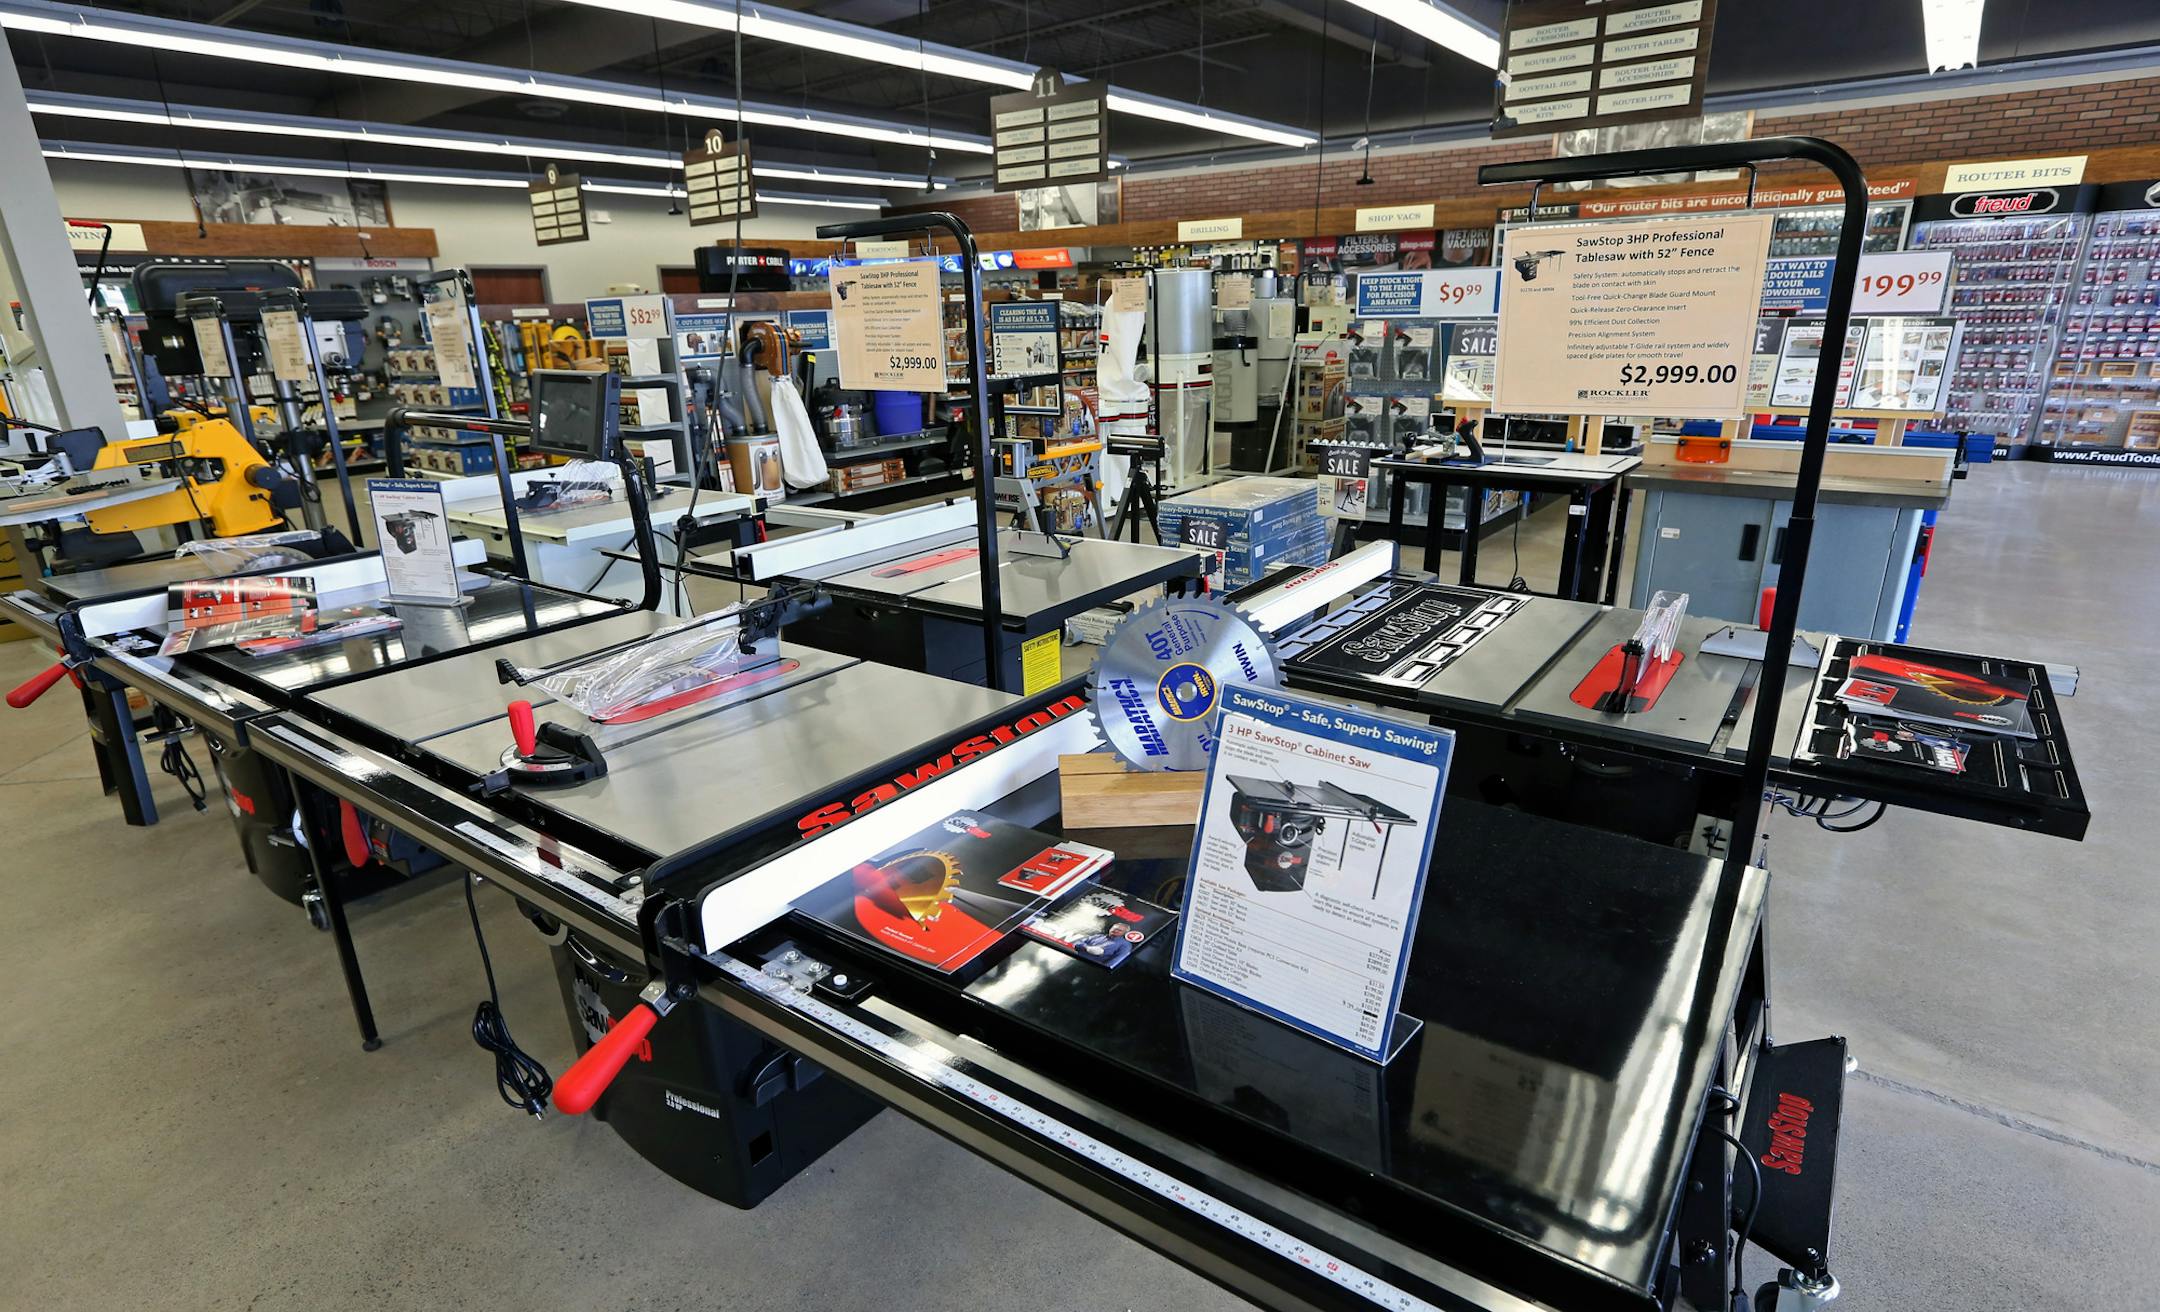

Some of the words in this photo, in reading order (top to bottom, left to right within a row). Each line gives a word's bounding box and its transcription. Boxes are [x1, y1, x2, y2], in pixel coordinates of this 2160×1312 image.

[1634, 9, 1670, 20] ROUTER
[1623, 14, 1682, 28] ACCESSORIES
[1536, 26, 1569, 36] ROUTER
[1526, 31, 1580, 44] ACCESSORIES
[1614, 42, 1650, 53] ROUTER
[1652, 37, 1685, 48] TABLES
[1524, 57, 1556, 66] ROUTER
[1558, 54, 1577, 62] JIGS
[1614, 67, 1650, 76] ROUTER
[1652, 62, 1680, 72] TABLE
[1616, 70, 1675, 83] ACCESSORIES
[1036, 76, 1056, 98] 11
[1518, 83, 1557, 92] DOVETAIL
[1558, 80, 1578, 88] JIGS
[1540, 103, 1573, 112] MAKING
[1612, 97, 1647, 106] ROUTER
[705, 136, 722, 154] 10
[548, 170, 556, 184] 9
[1957, 170, 2025, 183] ROUTER
[2032, 166, 2072, 178] BITS
[1619, 198, 1657, 212] router
[1660, 196, 1680, 209] bits
[1682, 197, 1708, 208] are
[1816, 180, 1910, 202] guateed”
[1513, 204, 1570, 216] ROKLER
[1973, 196, 2034, 214] freud
[1368, 214, 1394, 223] SHOP
[1397, 212, 1422, 221] VACS
[1190, 225, 1229, 234] DRILLING
[1345, 235, 1380, 246] FILTERS
[1448, 238, 1490, 249] VACUUM
[1576, 233, 1624, 248] SawStop
[1626, 234, 1650, 245] 3HP
[1652, 228, 1724, 242] Professional
[1338, 243, 1396, 255] ACCESSORIES
[1576, 251, 1628, 262] Tablesaw
[1629, 249, 1654, 260] with
[1680, 246, 1715, 258] Fence
[366, 260, 397, 268] BOSCH
[726, 256, 758, 266] PRTER
[766, 256, 784, 266] CABLE
[1788, 262, 1814, 270] WAY
[1814, 261, 1827, 269] TO
[860, 272, 880, 280] SawStop
[890, 270, 918, 278] Professional
[1574, 272, 1593, 280] Safety
[1621, 269, 1666, 279] automatically
[1667, 268, 1686, 276] stops
[1702, 266, 1726, 274] retract
[1770, 270, 1824, 279] DOVETAILS
[1312, 277, 1328, 285] SALE
[1401, 276, 1424, 284] TIGHT
[1572, 280, 1590, 288] blade
[1600, 280, 1624, 288] contact
[1776, 280, 1804, 288] YOUR
[1379, 284, 1392, 292] THE
[1393, 284, 1416, 292] FENCE
[1572, 294, 1600, 302] Tool-Free
[1602, 292, 1647, 302] Quick-Change
[1648, 290, 1668, 298] Blade
[1669, 290, 1690, 298] Guard
[1692, 289, 1716, 297] Mount
[1384, 298, 1413, 306] SAFETY
[1570, 305, 1614, 315] Quick-Release
[1615, 304, 1666, 313] Zero-Clearance
[1667, 304, 1687, 312] Insert
[1584, 318, 1609, 326] Efficient
[1627, 317, 1660, 326] Collection
[1597, 330, 1630, 339] Alignment
[1632, 330, 1656, 338] System
[995, 336, 1001, 346] 1
[1460, 338, 1496, 354] SALE
[1567, 344, 1594, 352] Infinitely
[1595, 343, 1628, 352] adjustable
[1666, 342, 1690, 350] system
[1691, 342, 1705, 350] and
[1706, 341, 1730, 350] widely
[996, 348, 1002, 358] 2
[1566, 352, 1588, 360] spaced
[1588, 352, 1604, 360] glide
[1604, 352, 1624, 360] plates
[890, 355, 937, 370] $2,999.00
[996, 360, 1002, 372] 3
[1620, 363, 1737, 388] $2,999.00
[1328, 455, 1359, 476] SALE
[1159, 505, 1192, 516] Heavy-Duty
[1192, 507, 1204, 516] Ball
[1204, 508, 1228, 518] Bearing
[1229, 510, 1248, 518] Stand
[1189, 528, 1218, 546] SALE
[1229, 545, 1248, 554] Stand
[1171, 614, 1193, 652] Purpose
[1342, 599, 1463, 663] SawStop
[1161, 622, 1184, 656] General
[1024, 642, 1036, 653] SAFETY
[1146, 630, 1172, 661] 40T
[1232, 642, 1258, 682] IRWIN
[1302, 710, 1332, 730] Safe,
[1334, 717, 1382, 740] Superb
[1384, 730, 1438, 756] Sawing!
[1228, 725, 1235, 734] 3
[1236, 726, 1252, 738] HP
[1304, 744, 1346, 764] Cabinet
[1348, 756, 1371, 770] Saw
[665, 1089, 720, 1119] Professional
[1760, 1092, 1814, 1176] SawStop
